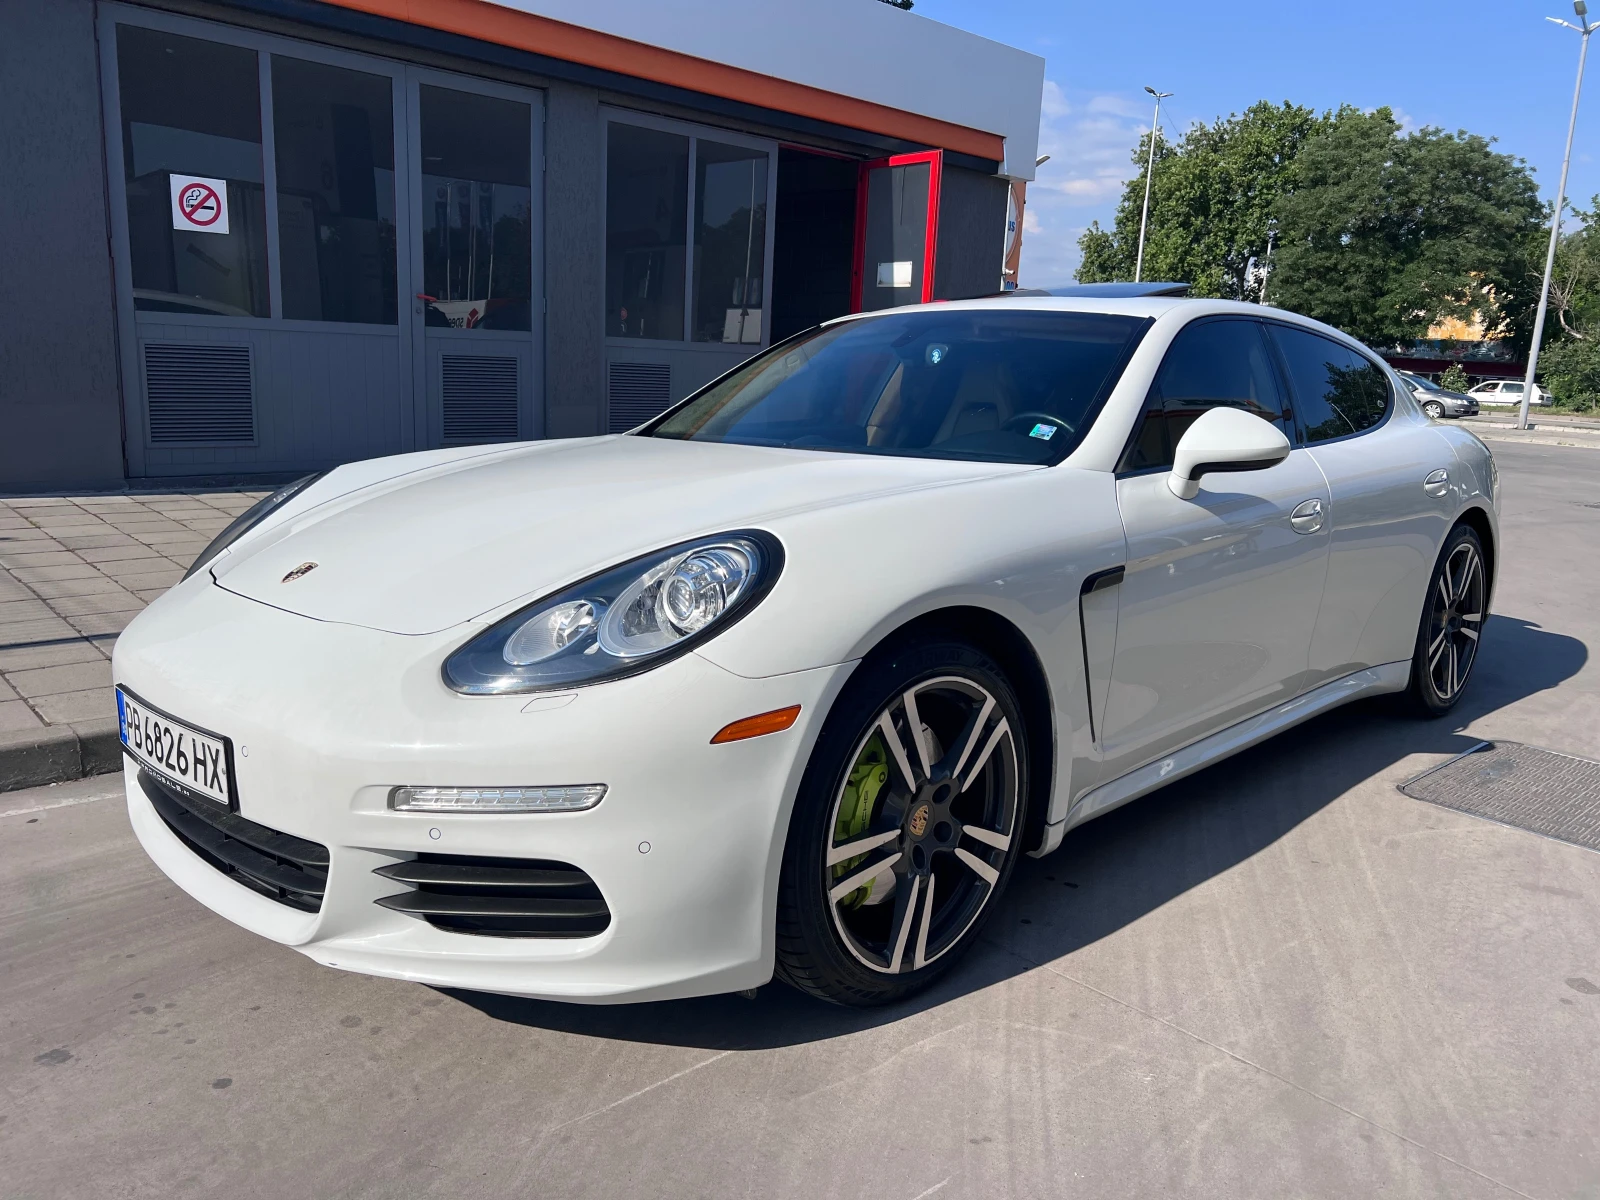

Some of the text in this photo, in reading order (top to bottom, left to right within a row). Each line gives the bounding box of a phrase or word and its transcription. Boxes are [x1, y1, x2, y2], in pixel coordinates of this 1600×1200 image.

[125, 700, 224, 794] PB 6826 HX
